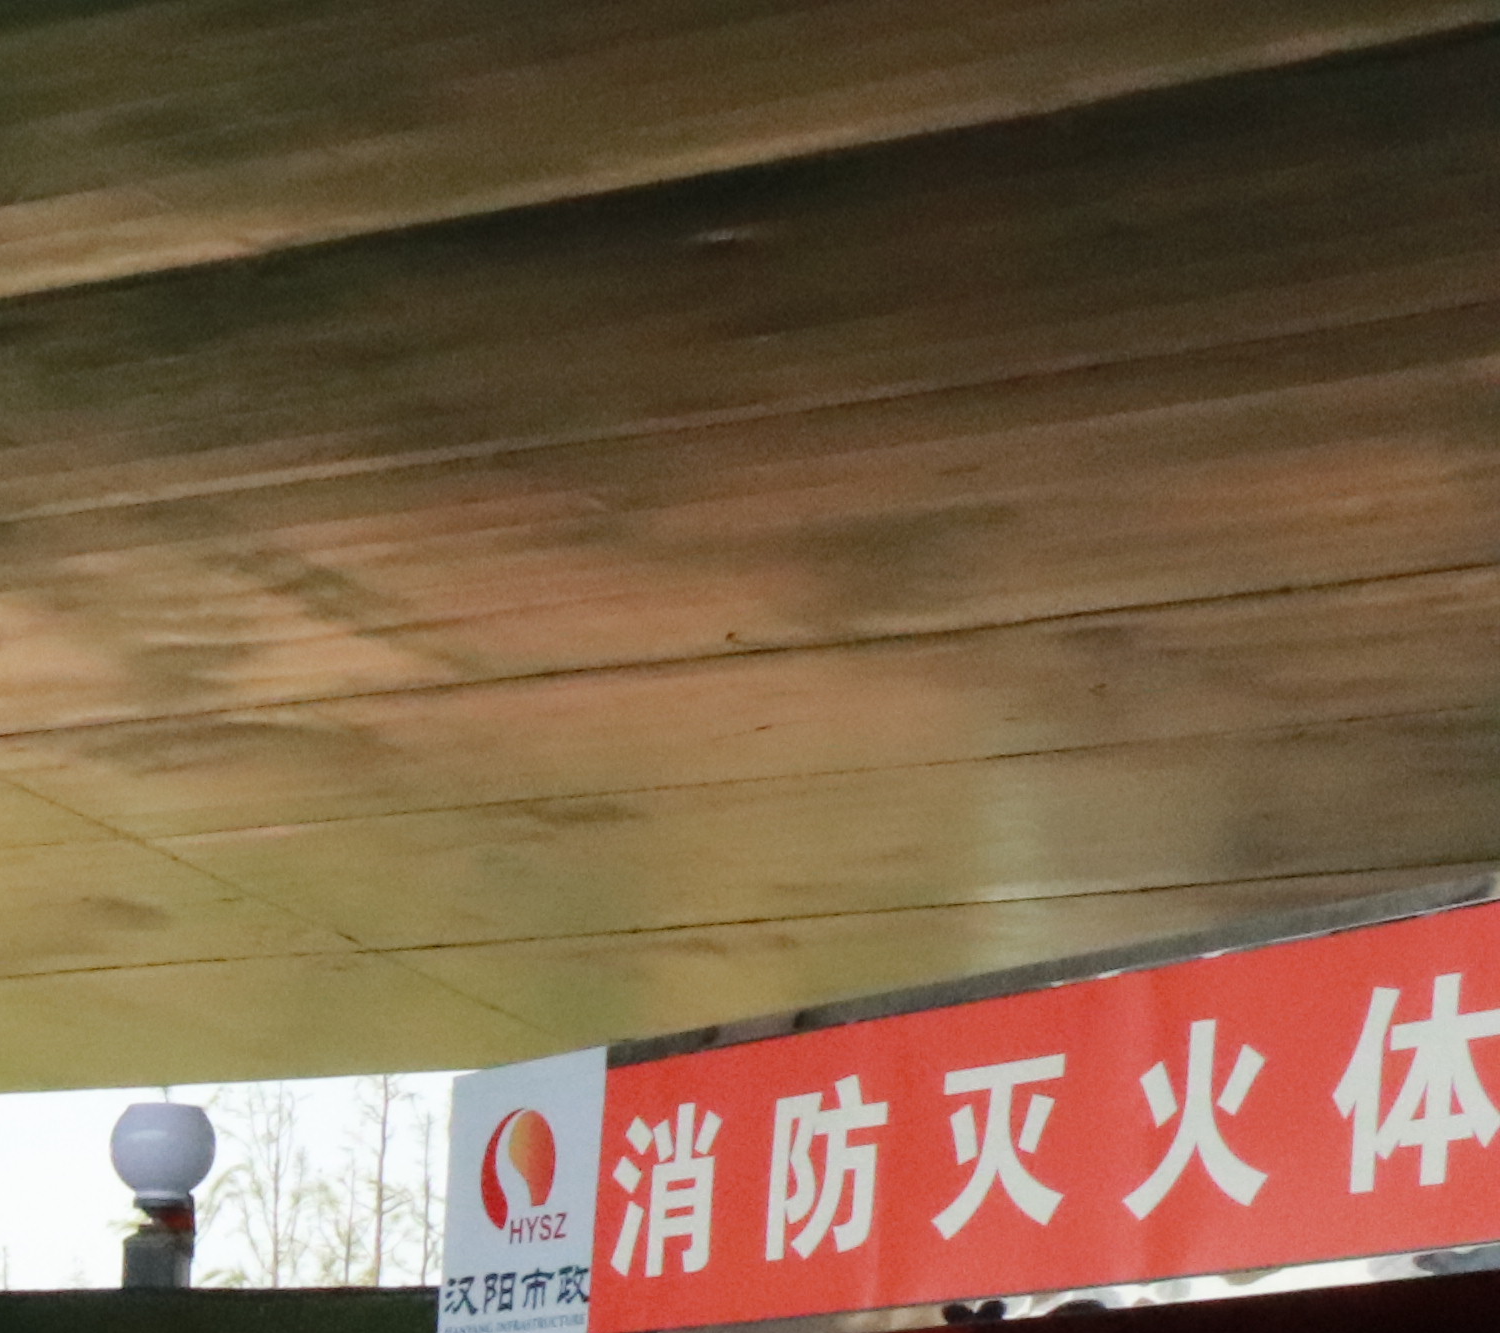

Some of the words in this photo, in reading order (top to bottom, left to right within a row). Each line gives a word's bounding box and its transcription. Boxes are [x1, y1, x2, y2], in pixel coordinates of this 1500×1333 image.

[612, 973, 1500, 1278] 消防灭火体
[510, 1212, 567, 1245] HYSZ
[444, 1265, 590, 1315] 汉阳市政
